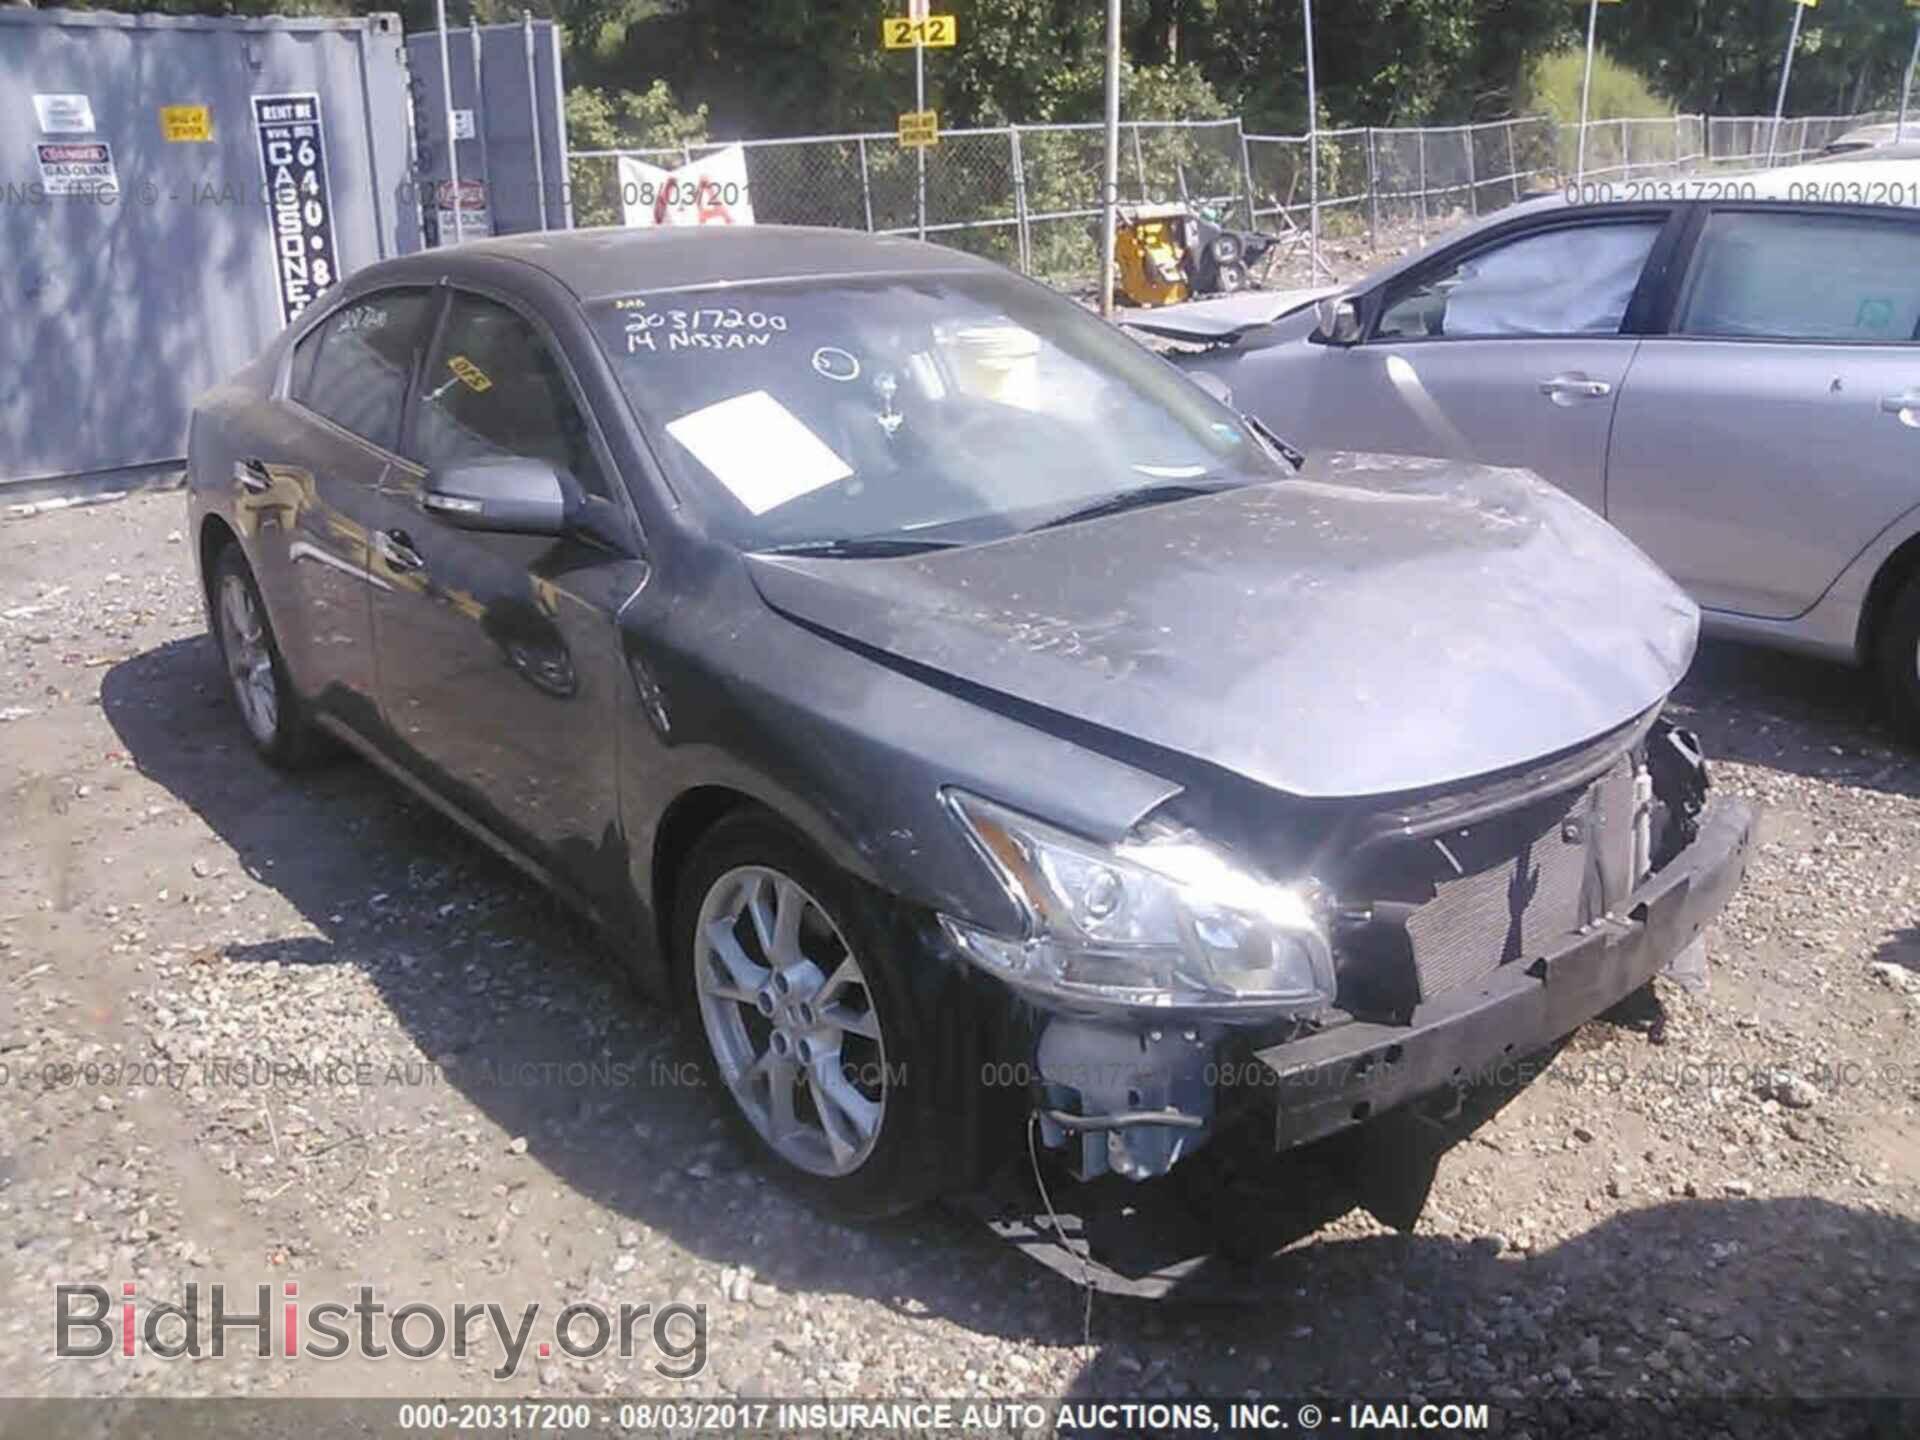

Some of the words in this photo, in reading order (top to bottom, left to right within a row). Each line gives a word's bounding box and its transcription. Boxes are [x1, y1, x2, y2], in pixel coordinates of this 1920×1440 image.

[895, 20, 945, 44] 212
[624, 309, 787, 332] 20317200
[627, 331, 656, 352] 14
[669, 329, 770, 350] NISSAN
